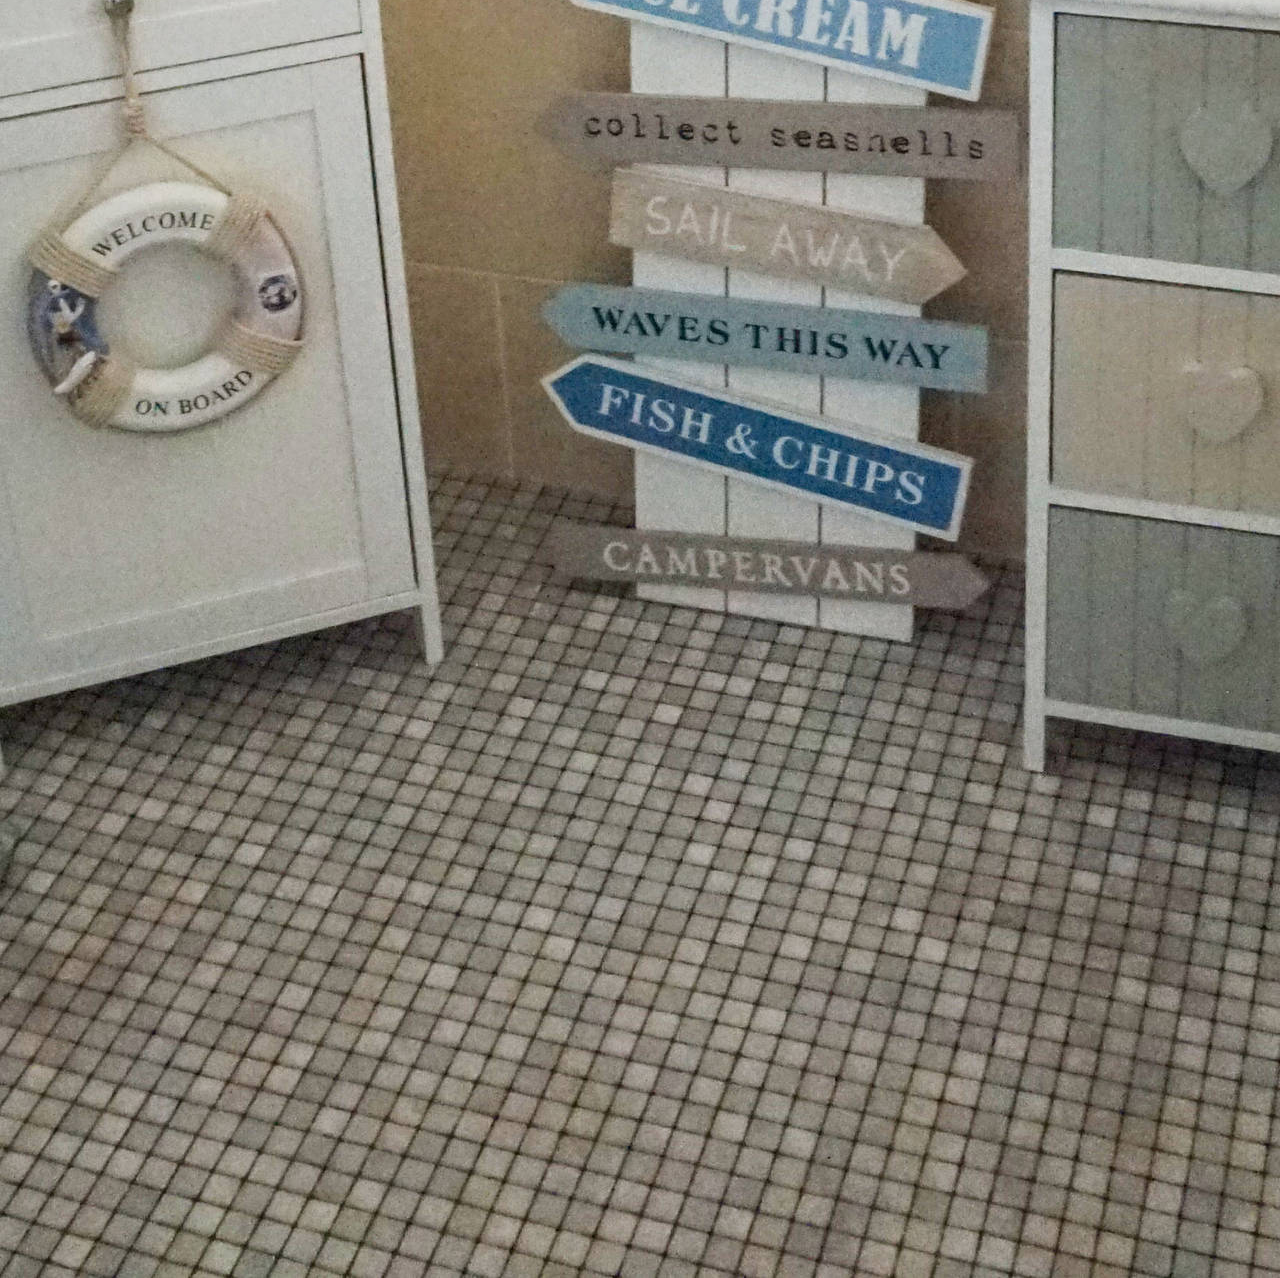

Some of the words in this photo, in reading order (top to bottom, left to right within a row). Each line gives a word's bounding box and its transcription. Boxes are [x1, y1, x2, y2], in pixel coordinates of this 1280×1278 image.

[584, 114, 742, 145] collect
[91, 211, 215, 257] WELCOME
[645, 196, 746, 252] SAIL
[770, 224, 907, 283] AWAY
[592, 306, 730, 347] WAVES
[745, 324, 848, 360] THIS
[865, 336, 951, 370] WAY
[135, 399, 170, 415] ON
[178, 370, 252, 414] BOARD
[597, 383, 711, 445] FISH
[725, 424, 758, 459] &
[772, 435, 927, 505] CHIPS
[602, 542, 913, 597] CAMPERVANS
